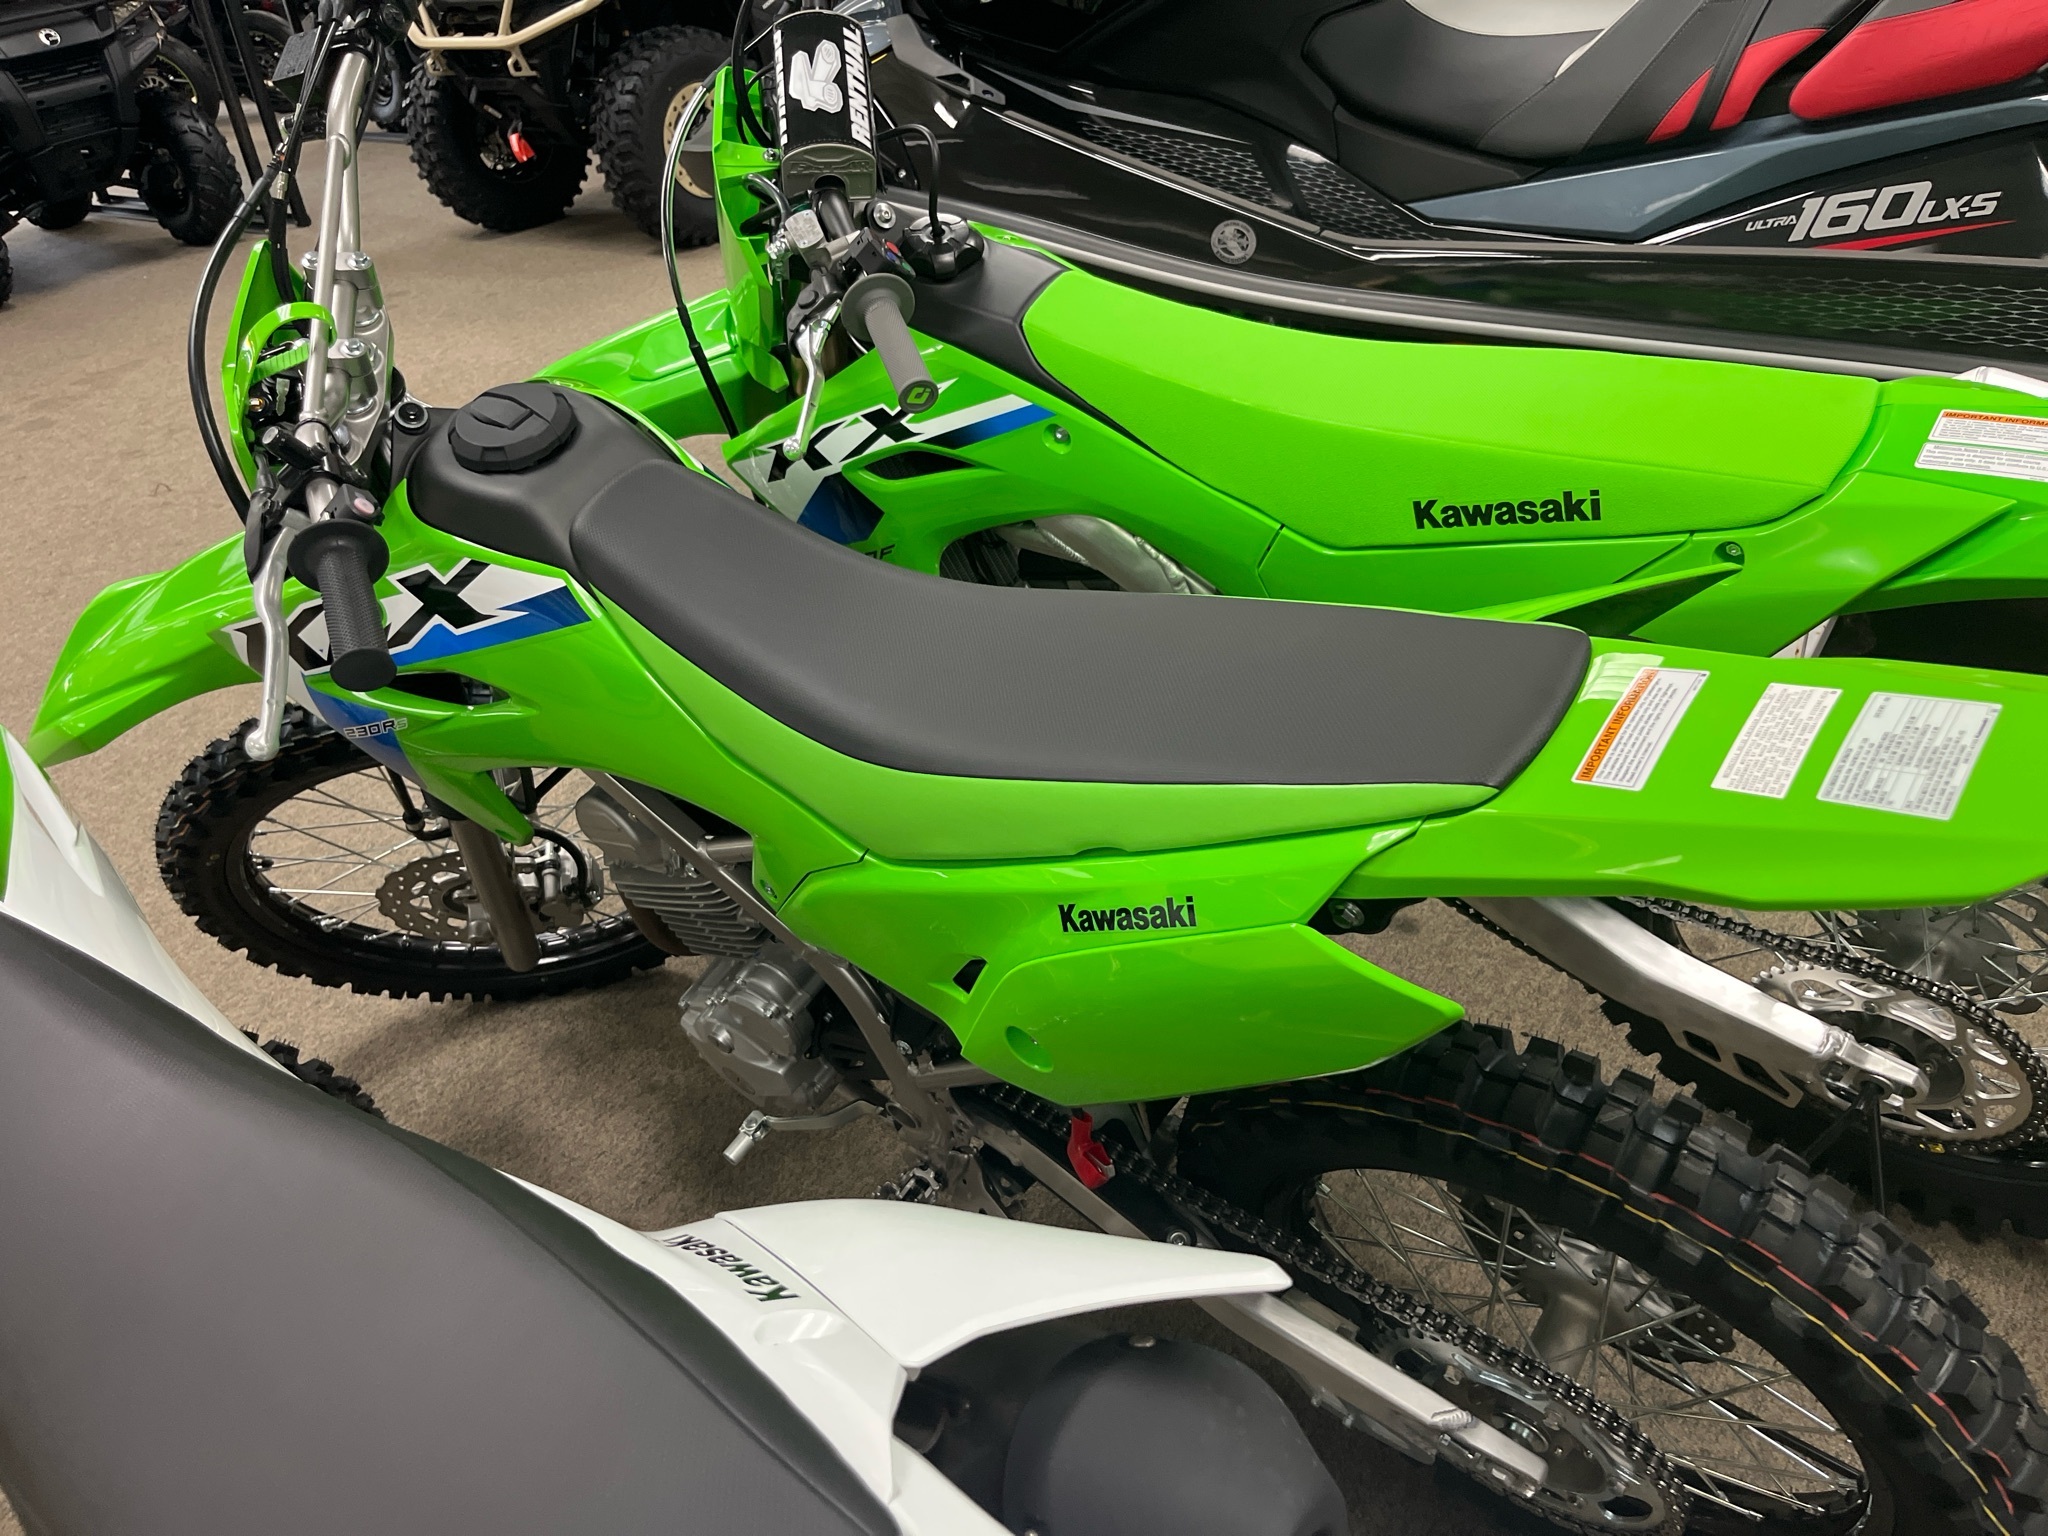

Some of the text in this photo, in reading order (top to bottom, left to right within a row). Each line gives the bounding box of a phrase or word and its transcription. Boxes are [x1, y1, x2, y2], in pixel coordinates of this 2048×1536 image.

[842, 25, 873, 149] RENTHAL
[1745, 215, 1797, 232] ULTRA
[1788, 180, 1932, 242] 160
[757, 402, 928, 482] KX
[1945, 412, 2003, 421] IMPORTANT
[1412, 489, 1602, 529] Kawasaki
[1580, 726, 1615, 778] IMPORTANT
[1057, 896, 1197, 932] Kawasaki
[662, 1234, 801, 1302] Kawasaki
